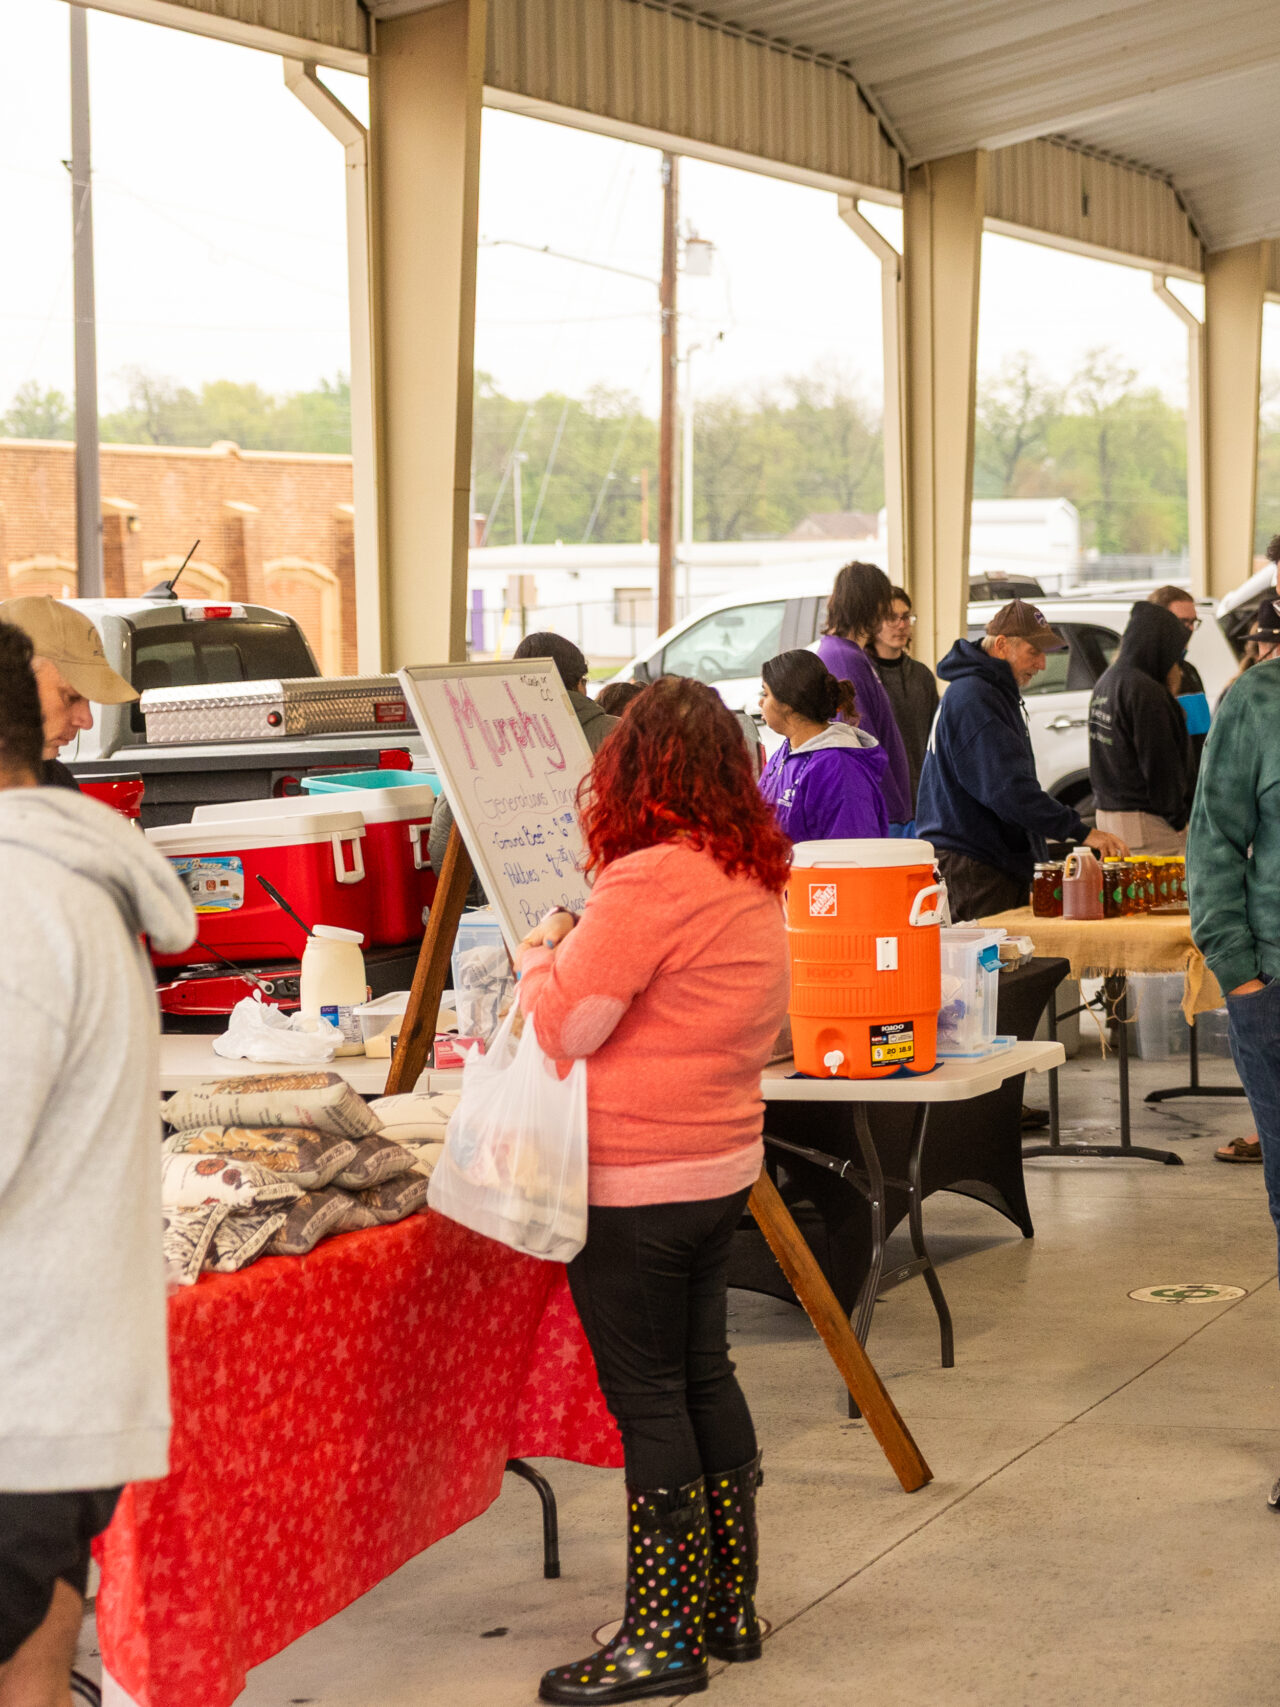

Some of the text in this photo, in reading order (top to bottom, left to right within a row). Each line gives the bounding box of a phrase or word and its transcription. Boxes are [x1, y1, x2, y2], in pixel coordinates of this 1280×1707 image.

[442, 678, 566, 778] Murphy
[810, 886, 836, 915] HOME
[886, 1047, 897, 1055] 20
[899, 1045, 912, 1053] 18.9
